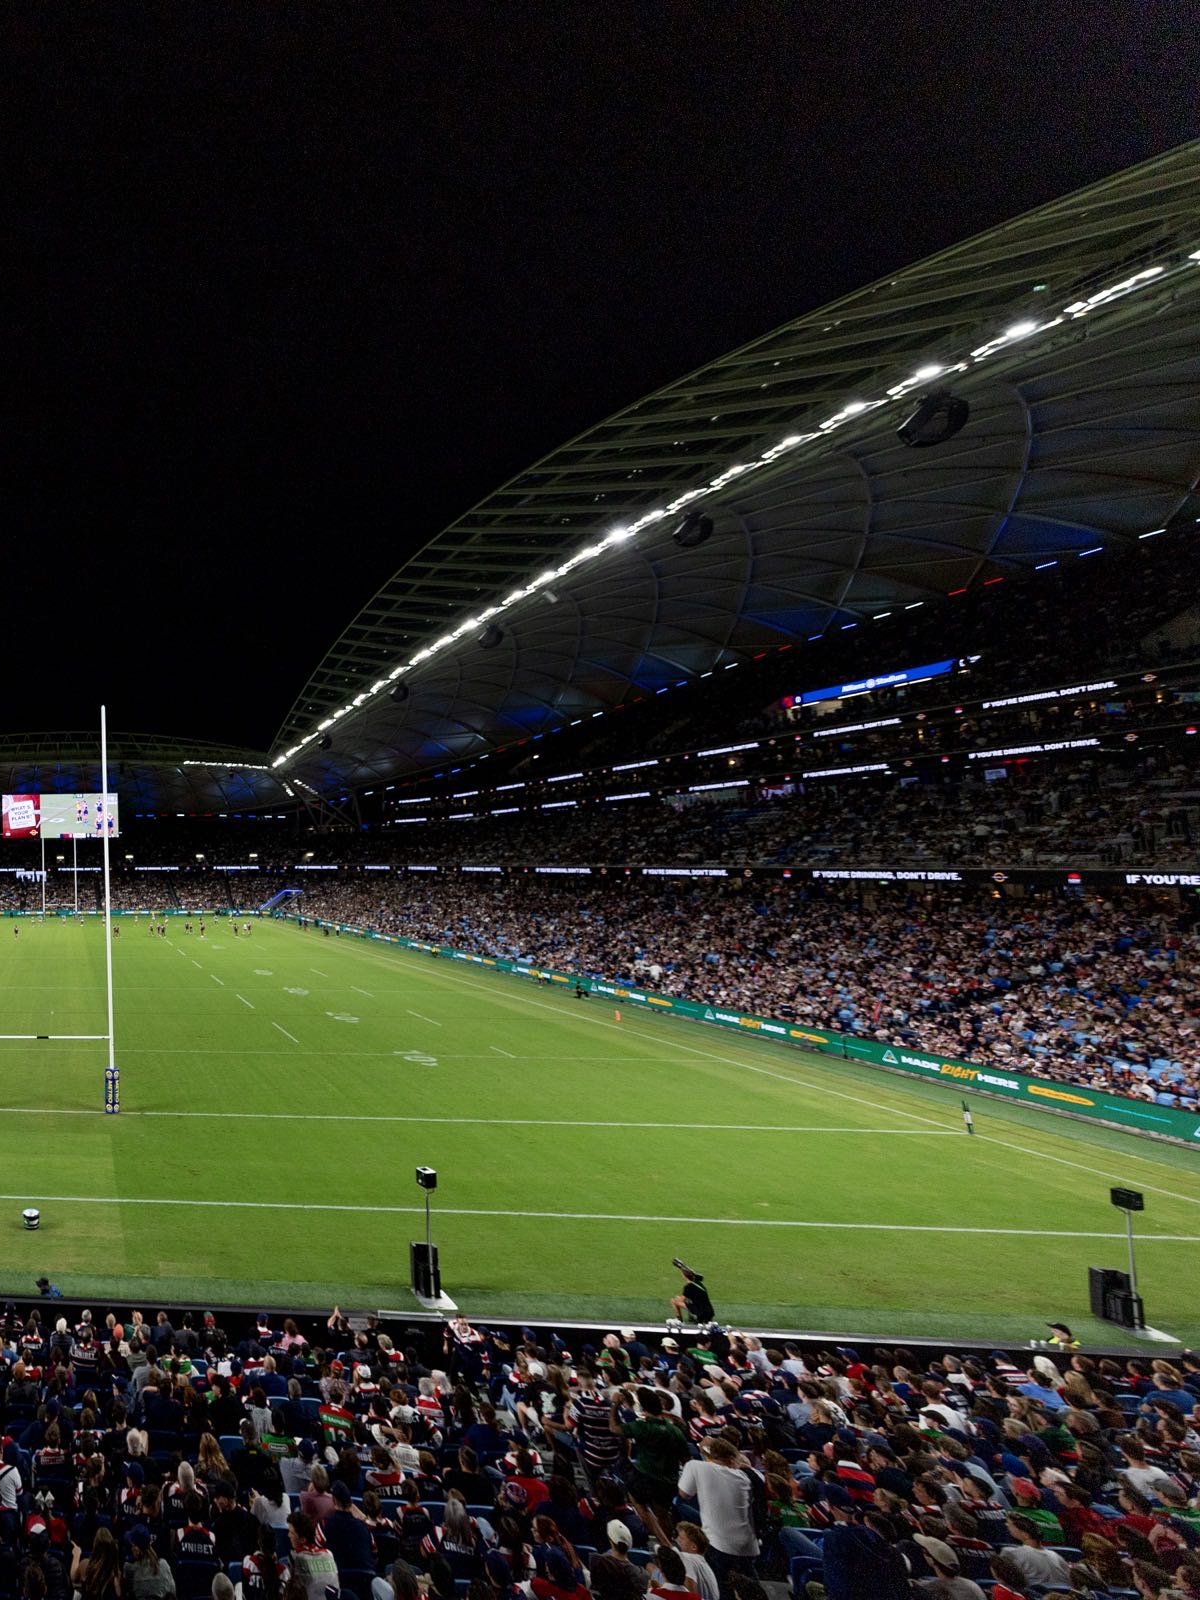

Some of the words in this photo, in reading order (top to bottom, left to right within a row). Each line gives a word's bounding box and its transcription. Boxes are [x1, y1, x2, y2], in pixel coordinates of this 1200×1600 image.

[991, 698, 1018, 707] YOU'RE
[1018, 691, 1060, 703] DRINKING,
[1060, 686, 1086, 696] DON'T
[1087, 681, 1118, 691] DRIVE.
[1004, 746, 1044, 755] DRINKING,
[1044, 742, 1070, 750] DON'T
[1071, 738, 1101, 747] DRIVE.
[850, 871, 896, 880] DRINKING,
[1126, 875, 1140, 884] IF
[1142, 875, 1200, 885] YOU'RE
[716, 1012, 740, 1023] MADE
[761, 1023, 786, 1034] HERE
[901, 1056, 940, 1071] MADE
[940, 1064, 980, 1080] RIGHT
[976, 1073, 1019, 1090] HERE
[392, 1484, 403, 1496] FO
[181, 1542, 213, 1555] UNIBET
